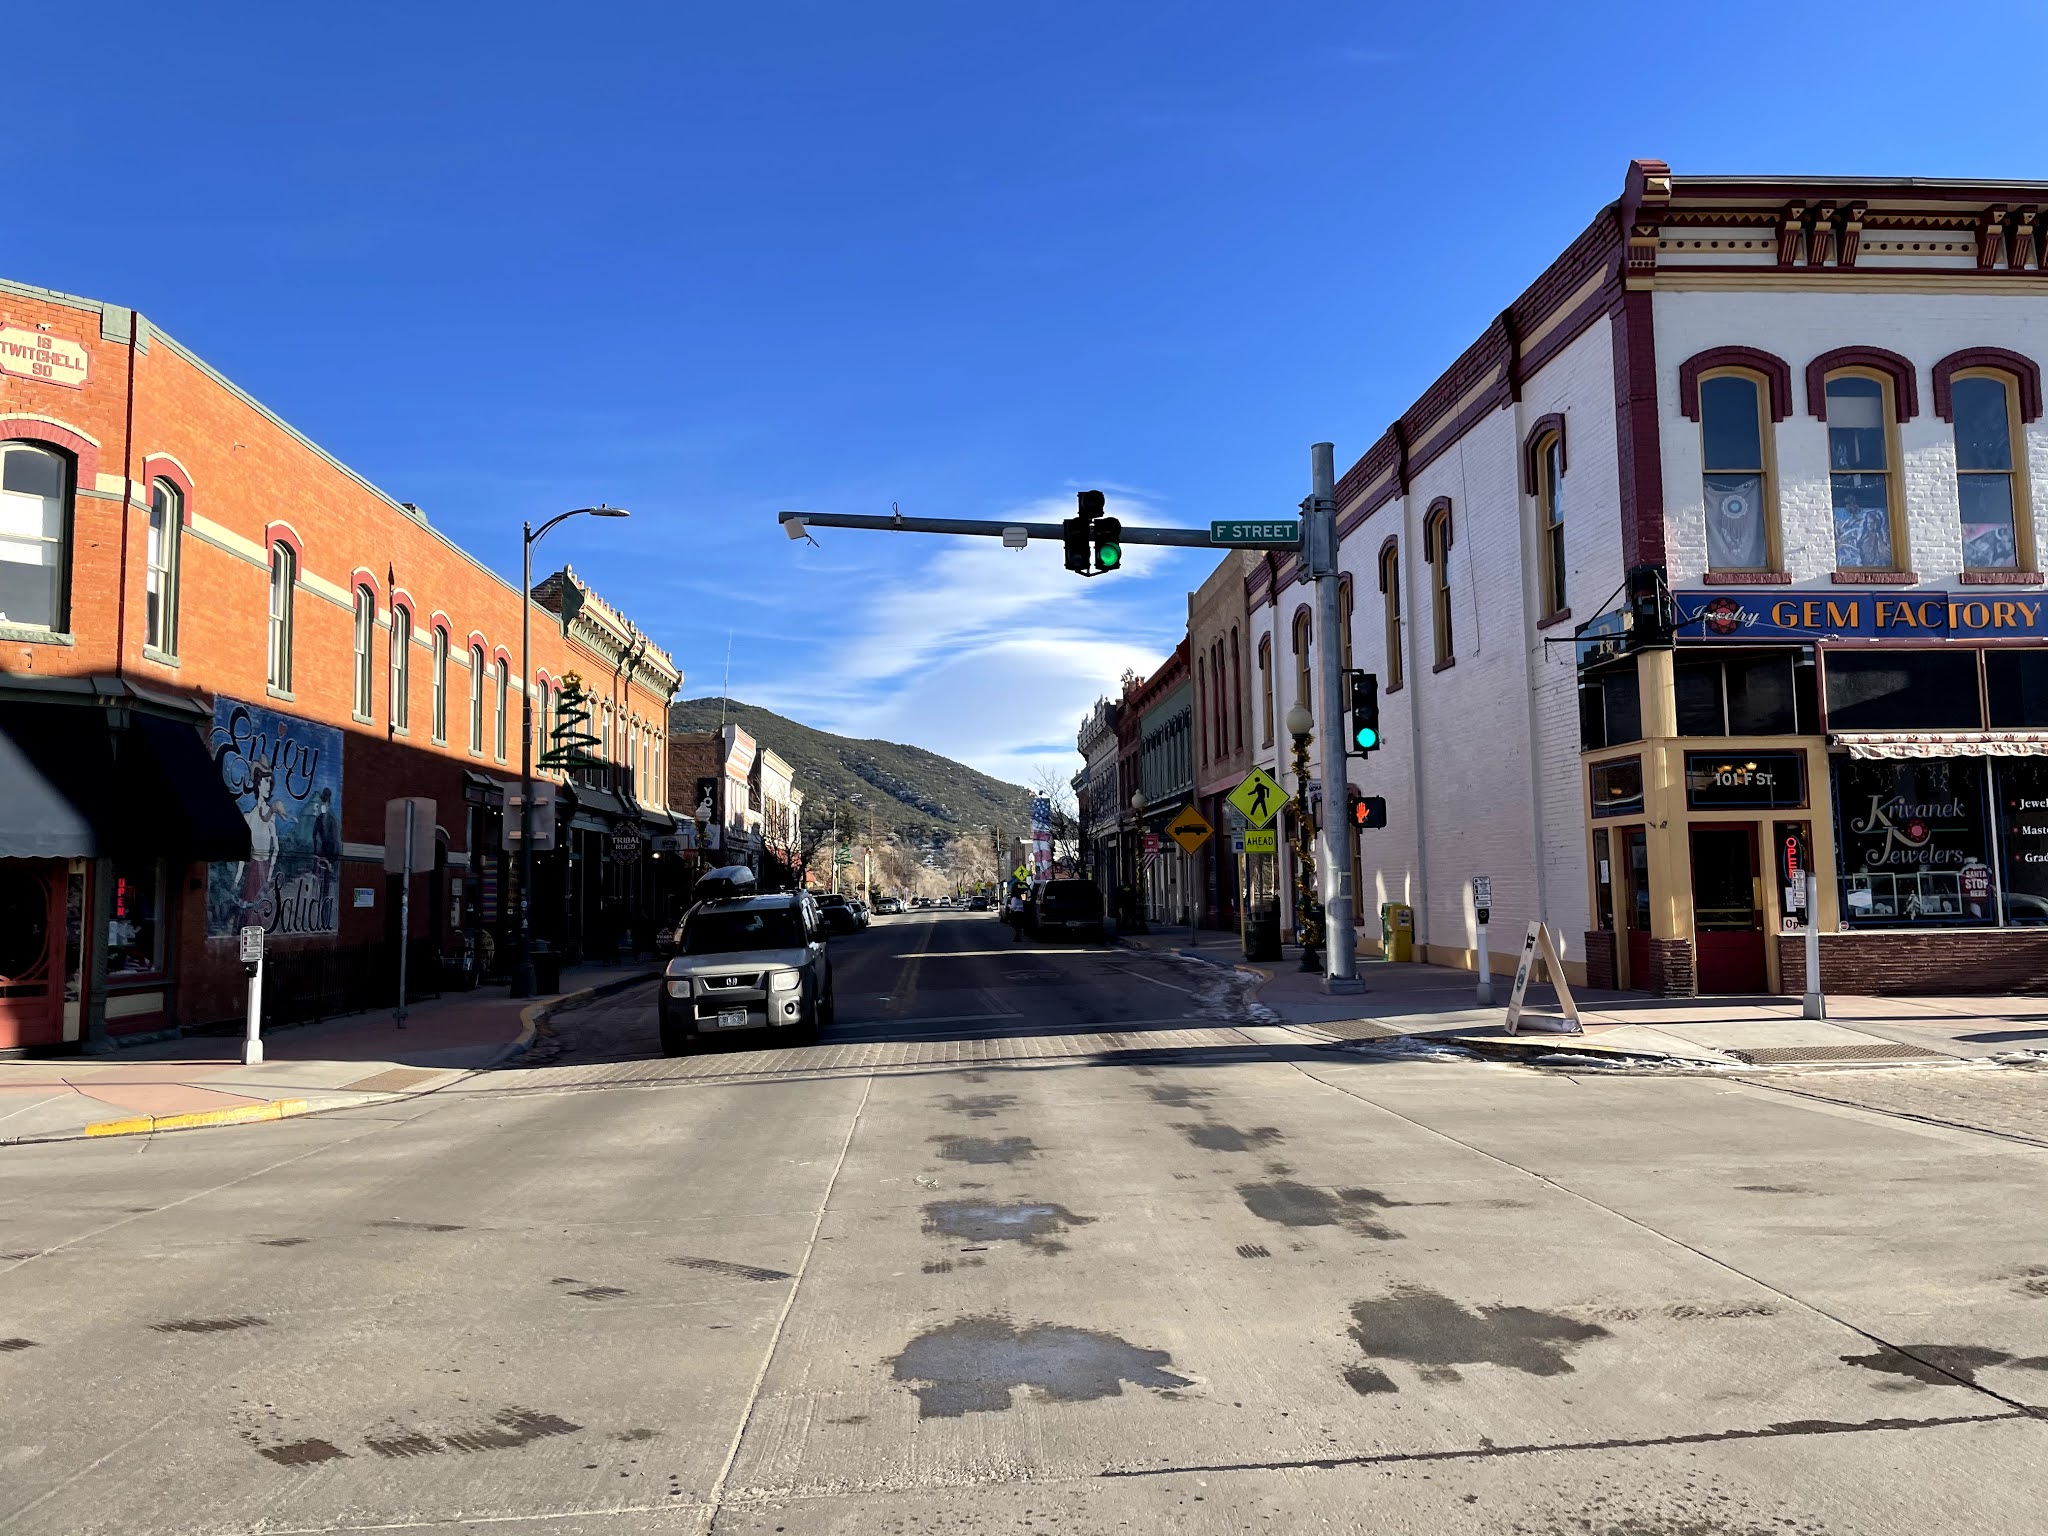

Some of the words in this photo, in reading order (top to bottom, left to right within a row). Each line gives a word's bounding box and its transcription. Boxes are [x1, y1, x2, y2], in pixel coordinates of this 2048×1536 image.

[0, 340, 85, 372] TWITCHELL
[32, 362, 53, 377] 90
[1216, 525, 1227, 538] F
[1232, 525, 1293, 538] STREET
[1771, 600, 1859, 628] GEM
[1876, 600, 2042, 629] FACTORY
[203, 704, 320, 801] Enjoy
[1713, 772, 1739, 786] 101
[1744, 772, 1753, 786] F
[1756, 772, 1777, 786] ST.
[1851, 794, 1966, 834] Krivanek
[612, 836, 641, 844] TRIBAL
[1246, 836, 1274, 846] AHEAD
[1866, 826, 1964, 867] Jewelers
[1965, 870, 1987, 878] SANTA
[1964, 878, 1989, 889] STOP
[117, 877, 126, 916] OPEN
[1970, 889, 1988, 898] HERE
[254, 872, 334, 935] Salida
